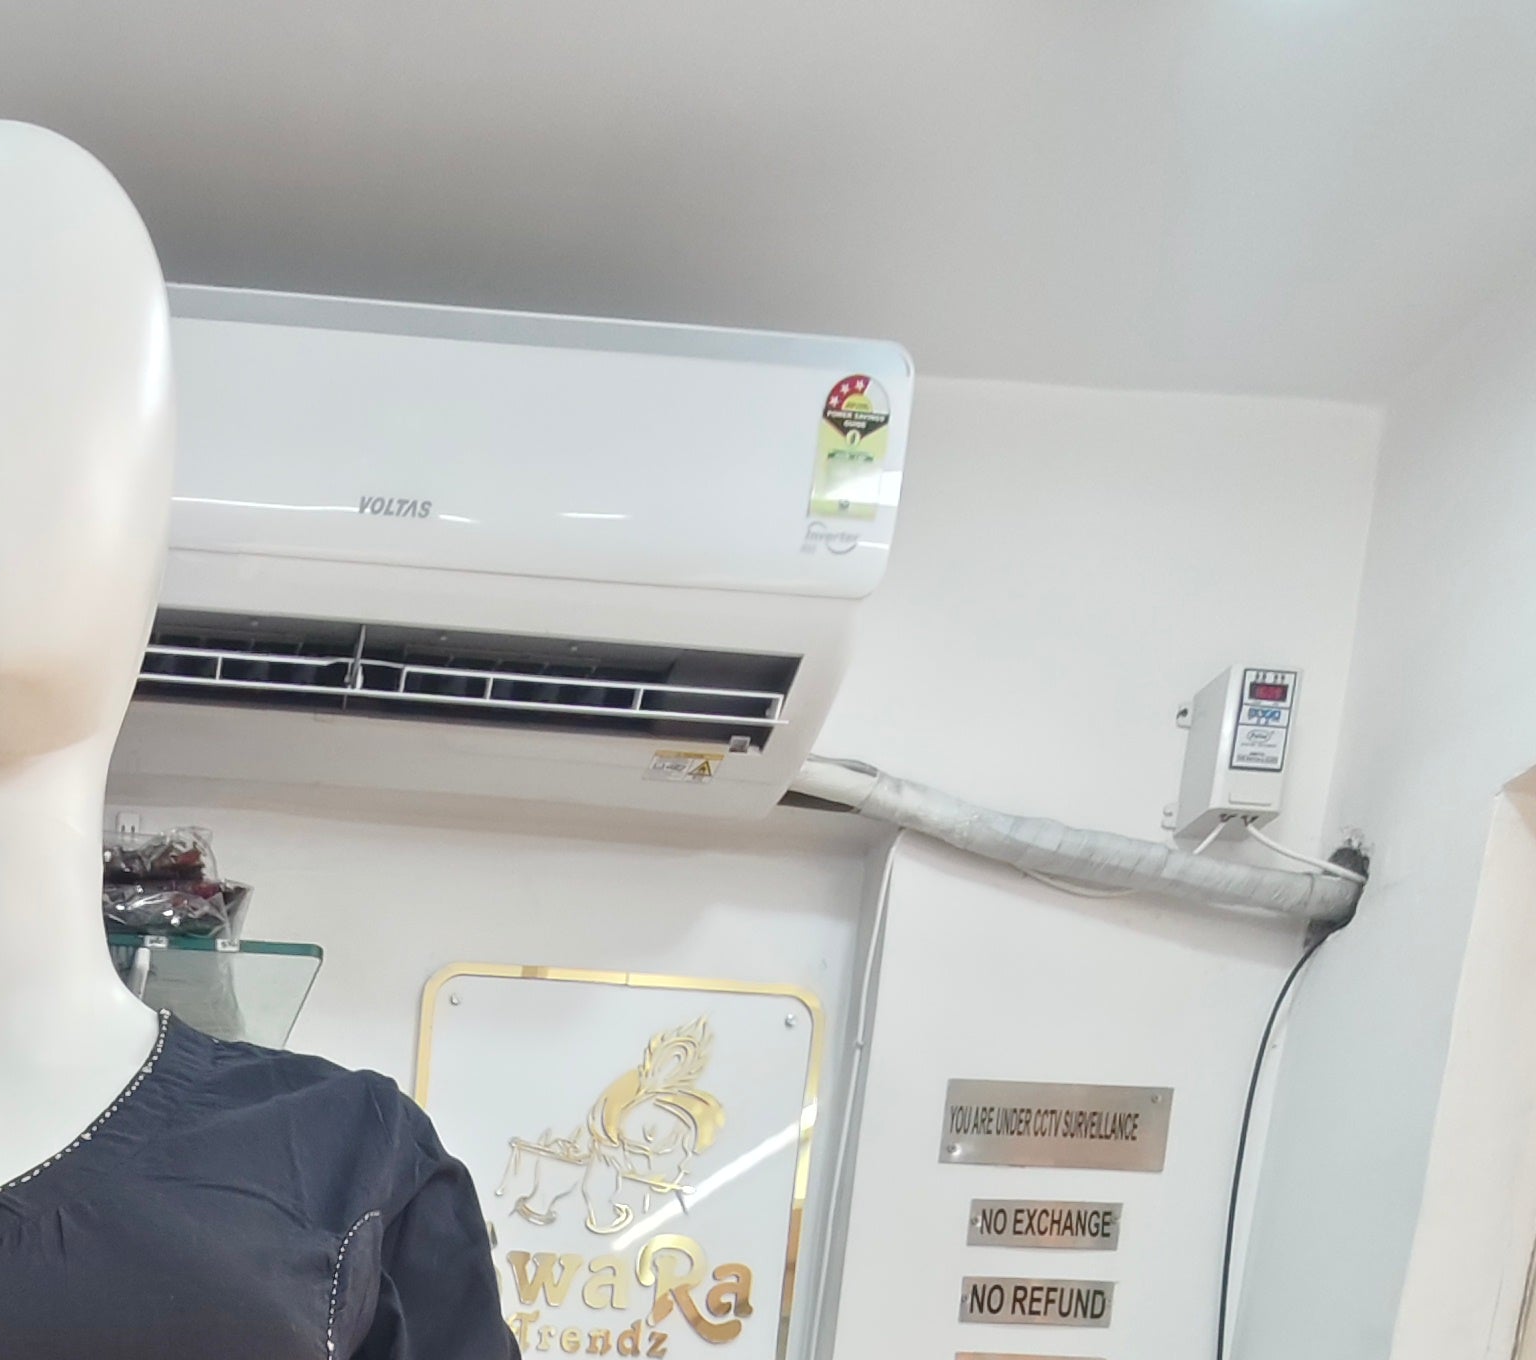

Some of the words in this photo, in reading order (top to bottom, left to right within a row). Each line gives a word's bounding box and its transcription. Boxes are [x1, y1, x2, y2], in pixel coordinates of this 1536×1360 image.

[359, 496, 432, 518] VOLTAS
[950, 1105, 972, 1135] YOU
[972, 1106, 994, 1135] ARE
[996, 1107, 1032, 1136] UNDER
[1033, 1108, 1063, 1137] CCTV
[1062, 1110, 1139, 1140] SURVEILLANCE
[980, 1208, 1007, 1235] NO
[1012, 1209, 1112, 1237] EXCHANGE
[486, 1220, 753, 1345] waRa
[970, 1284, 1004, 1315] NO
[1011, 1285, 1106, 1319] REFUND
[507, 1310, 669, 1359] Trendz
